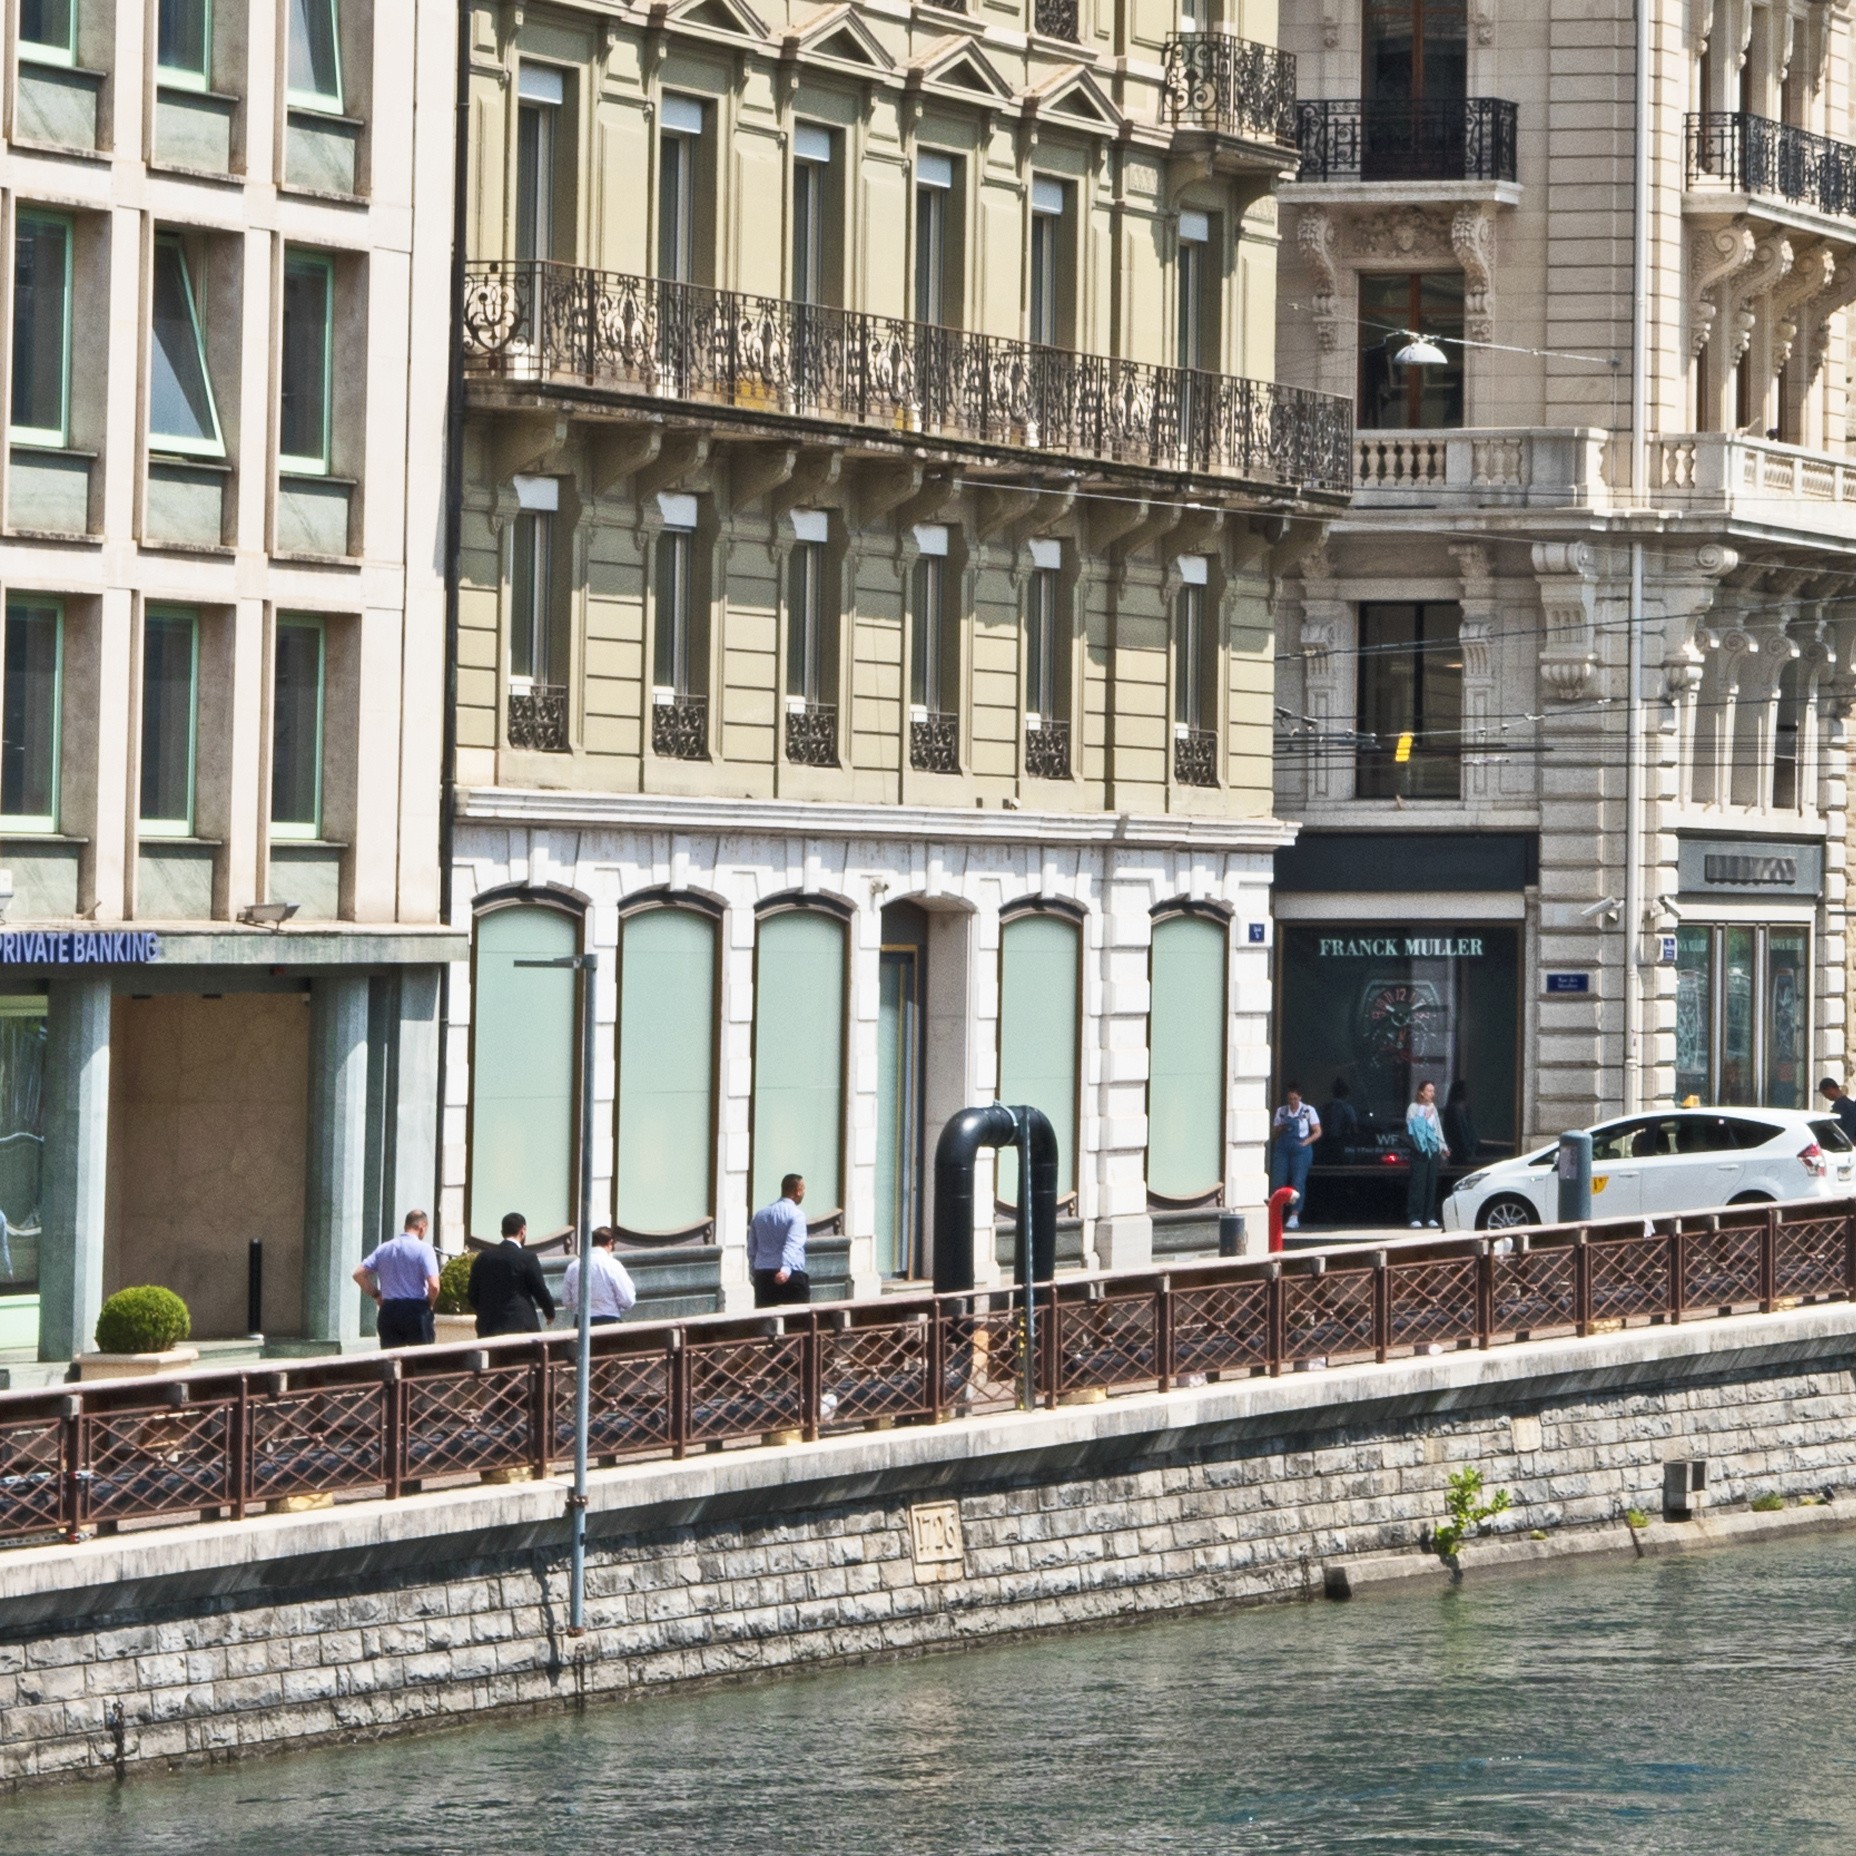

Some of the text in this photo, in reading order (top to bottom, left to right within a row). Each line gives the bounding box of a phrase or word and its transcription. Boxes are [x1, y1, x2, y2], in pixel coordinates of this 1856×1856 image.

[0, 931, 160, 963] RIVATE BANKING
[1319, 938, 1484, 956] FRANCK MULLER
[915, 1514, 957, 1551] 1726
